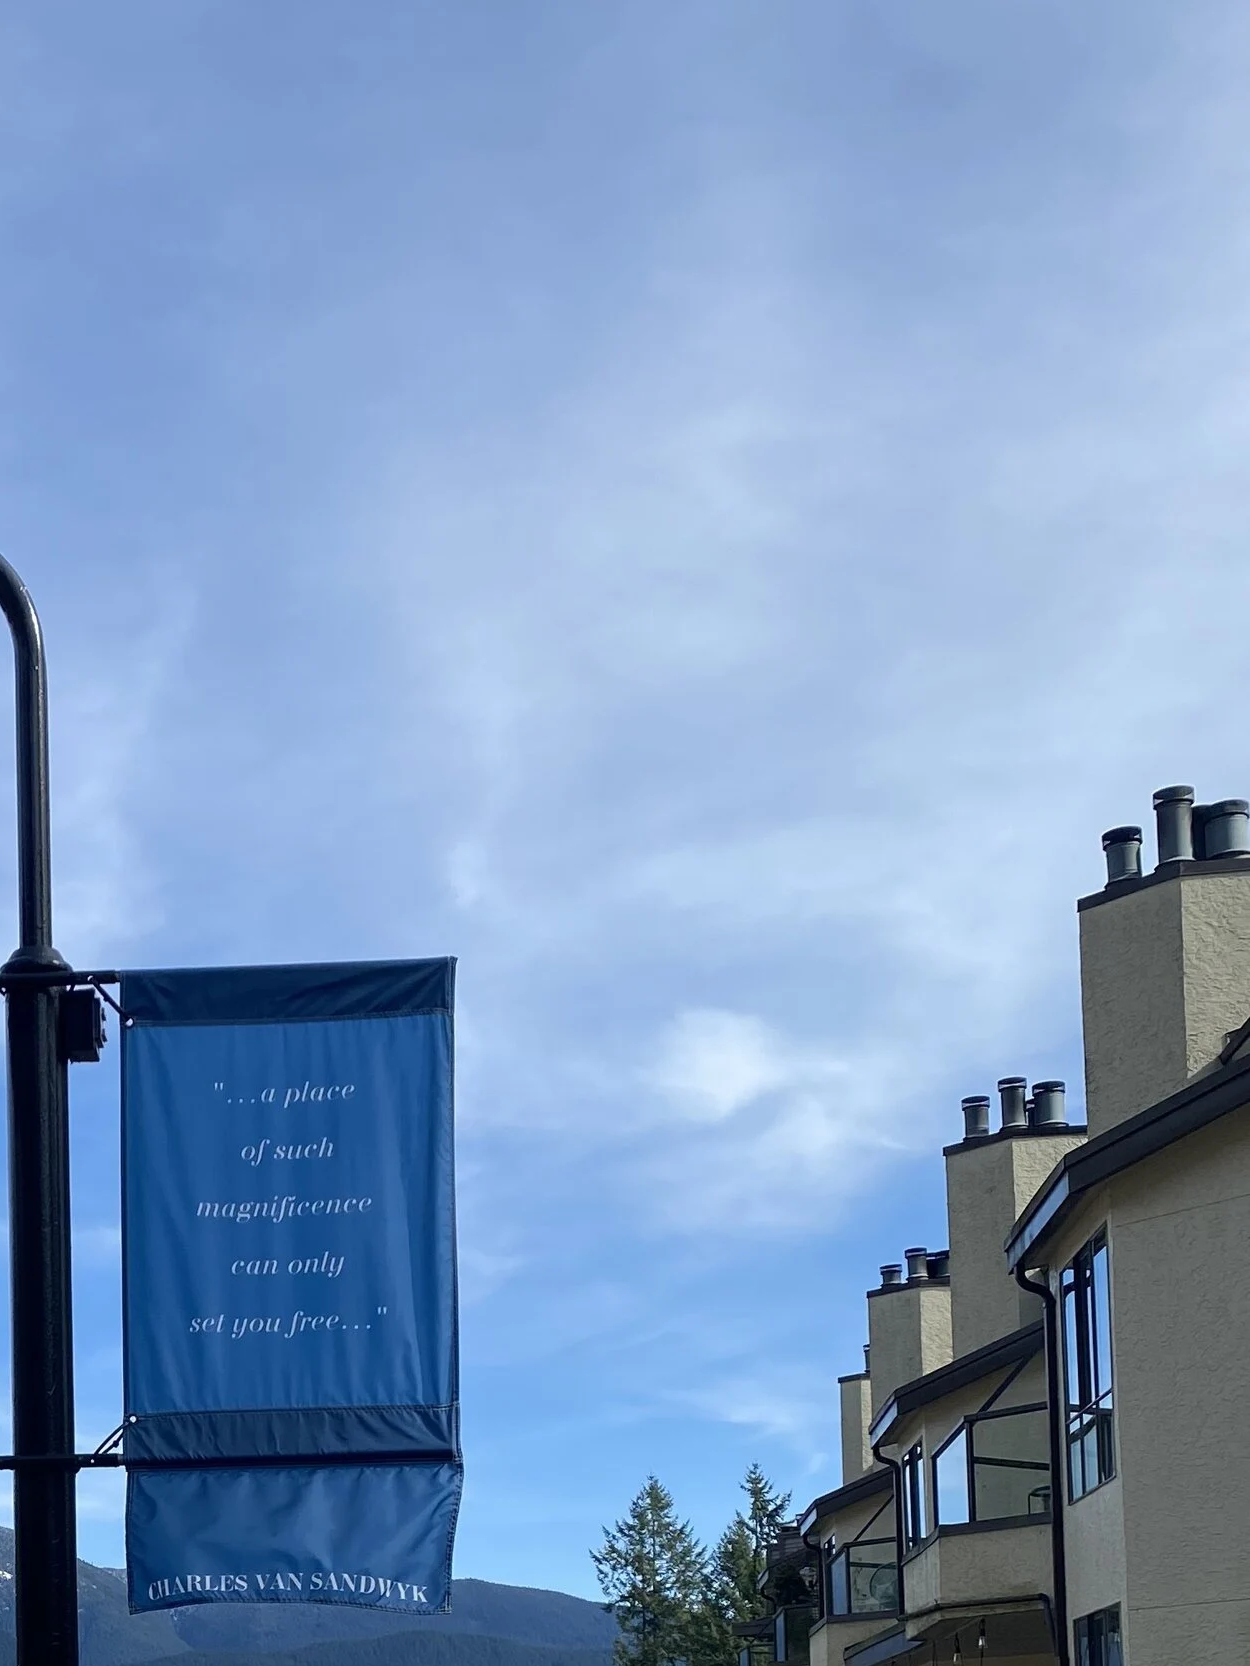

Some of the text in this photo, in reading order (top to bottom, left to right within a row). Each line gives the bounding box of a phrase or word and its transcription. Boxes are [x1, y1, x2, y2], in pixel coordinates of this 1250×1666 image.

[283, 1080, 356, 1109] place
[240, 1136, 334, 1167] of such
[196, 1195, 372, 1224] magnificence
[231, 1251, 345, 1278] can only
[189, 1313, 226, 1333] set
[231, 1316, 282, 1339] you
[148, 1572, 428, 1603] CHARLES VAN SANDWYK
